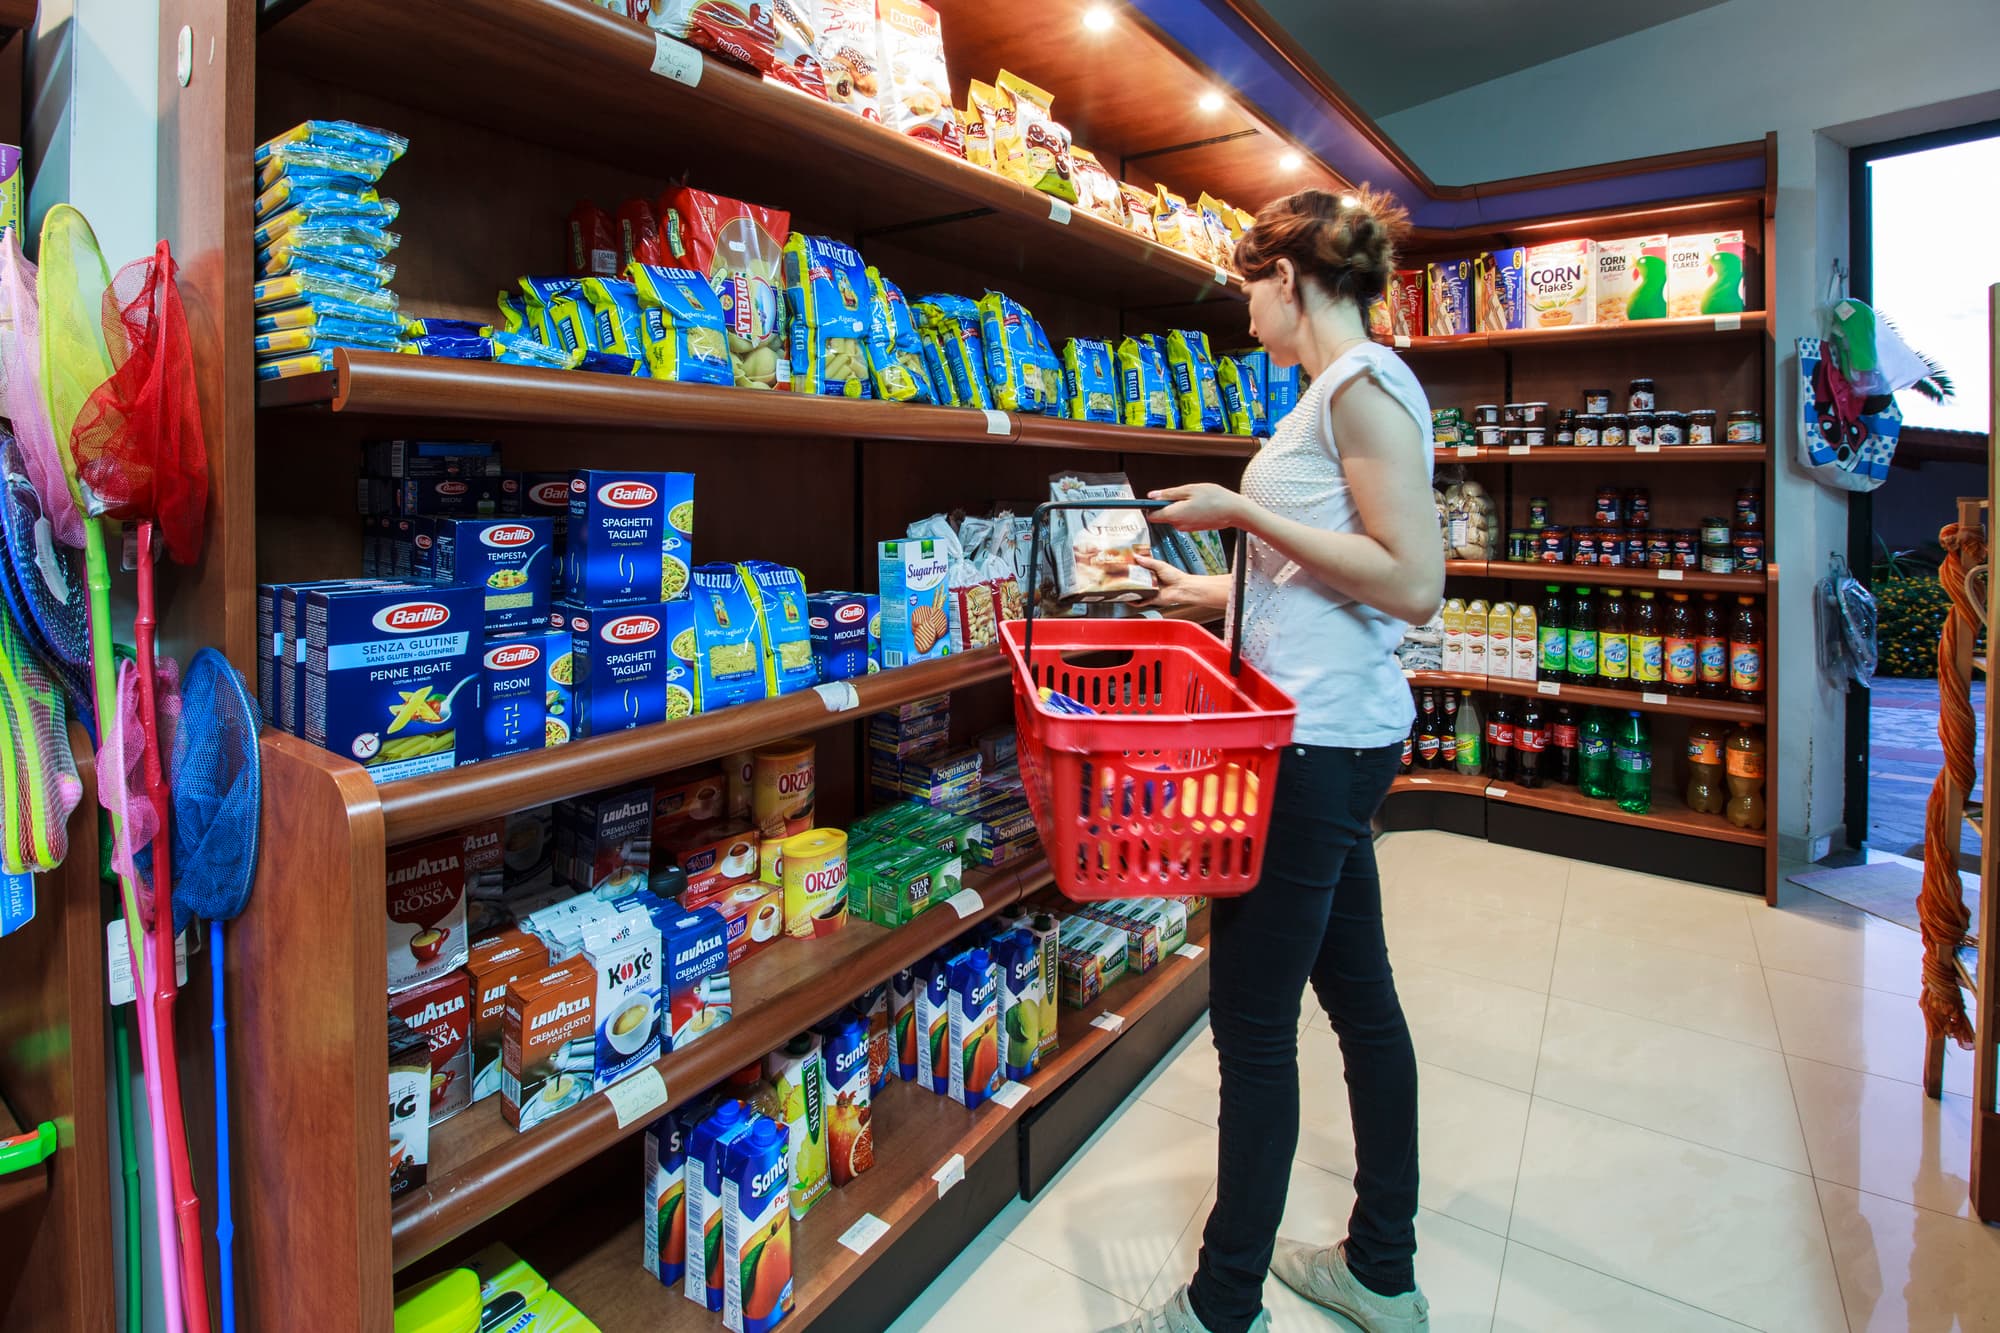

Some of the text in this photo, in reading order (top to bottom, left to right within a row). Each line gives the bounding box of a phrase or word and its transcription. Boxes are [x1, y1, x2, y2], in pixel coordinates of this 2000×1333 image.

[1600, 256, 1626, 266] CORN
[1672, 252, 1699, 262] CORN
[1673, 261, 1699, 269] FLAKES
[1530, 265, 1581, 286] CORN
[1600, 264, 1626, 273] FLAKES
[735, 278, 752, 333] DIVELLA
[612, 487, 653, 500] Barilla
[602, 518, 653, 528] SPAGHETTI
[493, 530, 531, 541] Barilla
[608, 529, 648, 540] TAGLIATI
[487, 552, 528, 561] TEMPESTA
[907, 561, 947, 581] Sugar Free
[391, 607, 444, 625] Barilla
[842, 608, 863, 618] Barilla
[615, 621, 656, 637] Barilla
[834, 628, 866, 640] MIDOLLINE
[362, 635, 459, 655] SENZA GLUTINE
[366, 647, 455, 663] SANS GLUTEN GLUTENFREI
[496, 649, 535, 664] Barilla
[606, 650, 656, 665] SPAGHETTI
[370, 661, 451, 681] PENNE RIGATE
[611, 663, 652, 676] TAGLIATI
[493, 677, 531, 692] RISONI
[602, 801, 649, 824] LAVAZZA
[387, 855, 460, 886] LAVAZZA
[910, 877, 929, 893] STAR
[9, 877, 25, 918] adriatic
[393, 886, 457, 916] ROSSA
[914, 889, 928, 900] TEA
[675, 935, 723, 966] LAVAZZA
[675, 965, 700, 980] CREMA
[703, 951, 725, 968] GUSTO
[685, 963, 717, 982] CLASSICO
[1047, 942, 1055, 995] SKIPPER
[623, 972, 652, 995] Audace
[530, 996, 591, 1031] LAVAZZA
[529, 1028, 559, 1046] CREMA
[563, 1014, 591, 1032] GUSTO
[547, 1029, 572, 1046] FORTE
[428, 1028, 462, 1053] SSA
[806, 1066, 819, 1132] SKIPPER
[801, 1173, 829, 1202] ANANA
